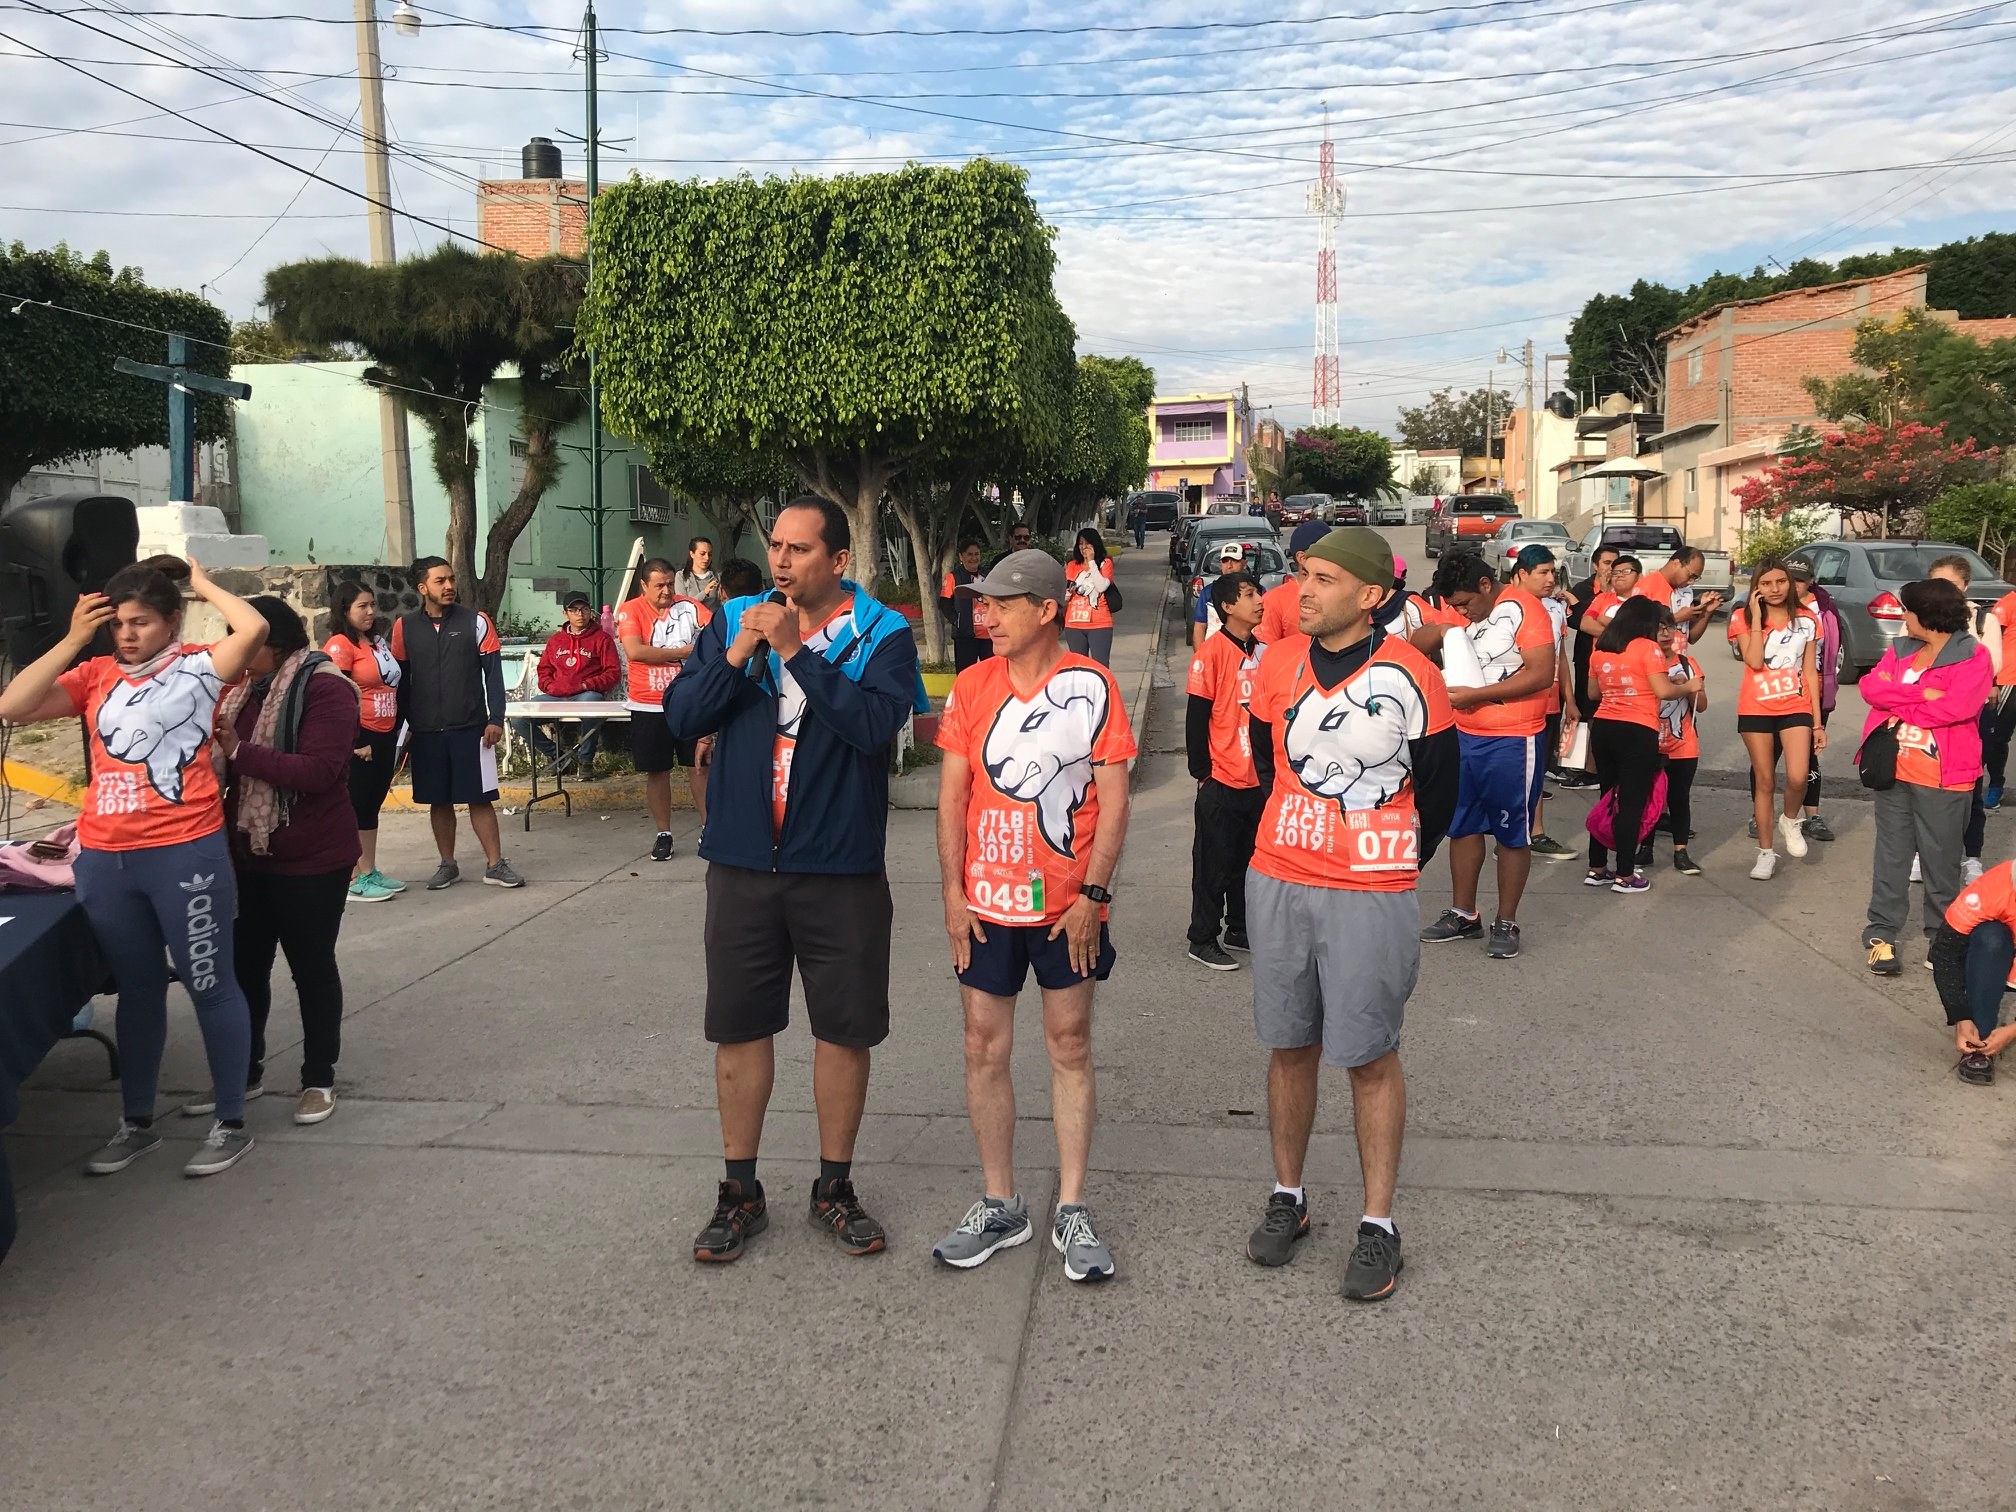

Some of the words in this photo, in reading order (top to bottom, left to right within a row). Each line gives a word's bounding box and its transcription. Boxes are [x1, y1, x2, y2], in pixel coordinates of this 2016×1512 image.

[1071, 610, 1089, 619] 179
[649, 666, 676, 676] UTLB
[1760, 676, 1794, 695] 113
[374, 708, 394, 717] 2019
[97, 798, 138, 816] 2019
[1282, 793, 1327, 815] UTLB
[979, 809, 1024, 829] UTLB
[1027, 811, 1034, 822] US
[1278, 808, 1327, 832] RACE
[1328, 811, 1336, 833] WITH
[1500, 809, 1510, 829] 2
[978, 826, 1024, 846] RACE
[1026, 824, 1034, 845] WITH
[1274, 826, 1325, 851] 2019
[978, 842, 1024, 864] 2019
[1357, 829, 1418, 861] 072
[974, 880, 1035, 913] 049
[187, 894, 220, 992] adidas
